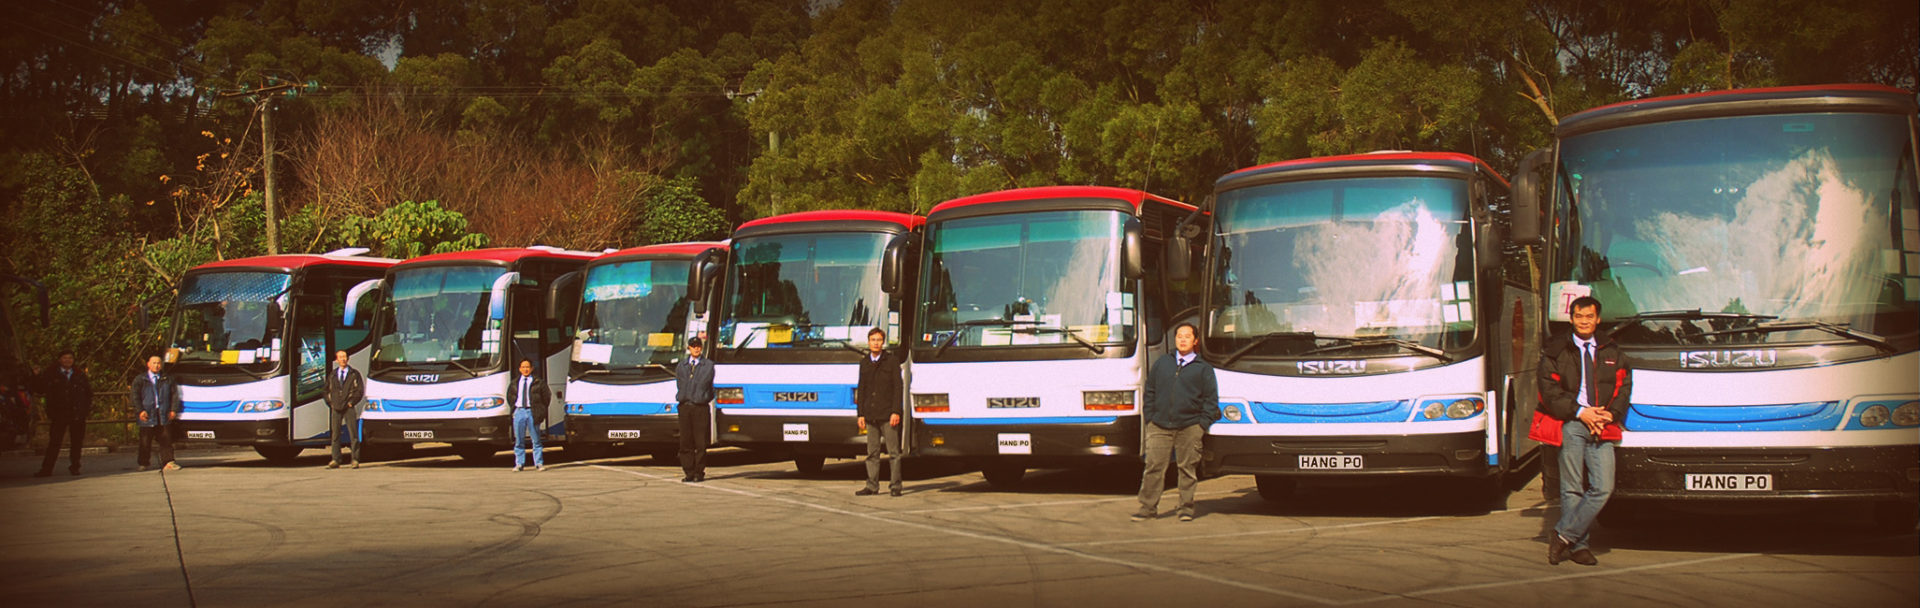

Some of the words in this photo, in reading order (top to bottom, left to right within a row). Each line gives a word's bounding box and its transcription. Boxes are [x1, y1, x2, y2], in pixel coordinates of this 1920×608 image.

[1680, 349, 1777, 368] ISUZU
[1297, 360, 1367, 374] ISUZU
[405, 374, 440, 382] ISUZU
[774, 392, 818, 401] ISUZU
[986, 397, 1041, 408] ISUZU
[1301, 456, 1337, 468] HANG
[1343, 457, 1361, 468] PO
[1692, 476, 1737, 489] HANG
[1745, 476, 1767, 489] PO
